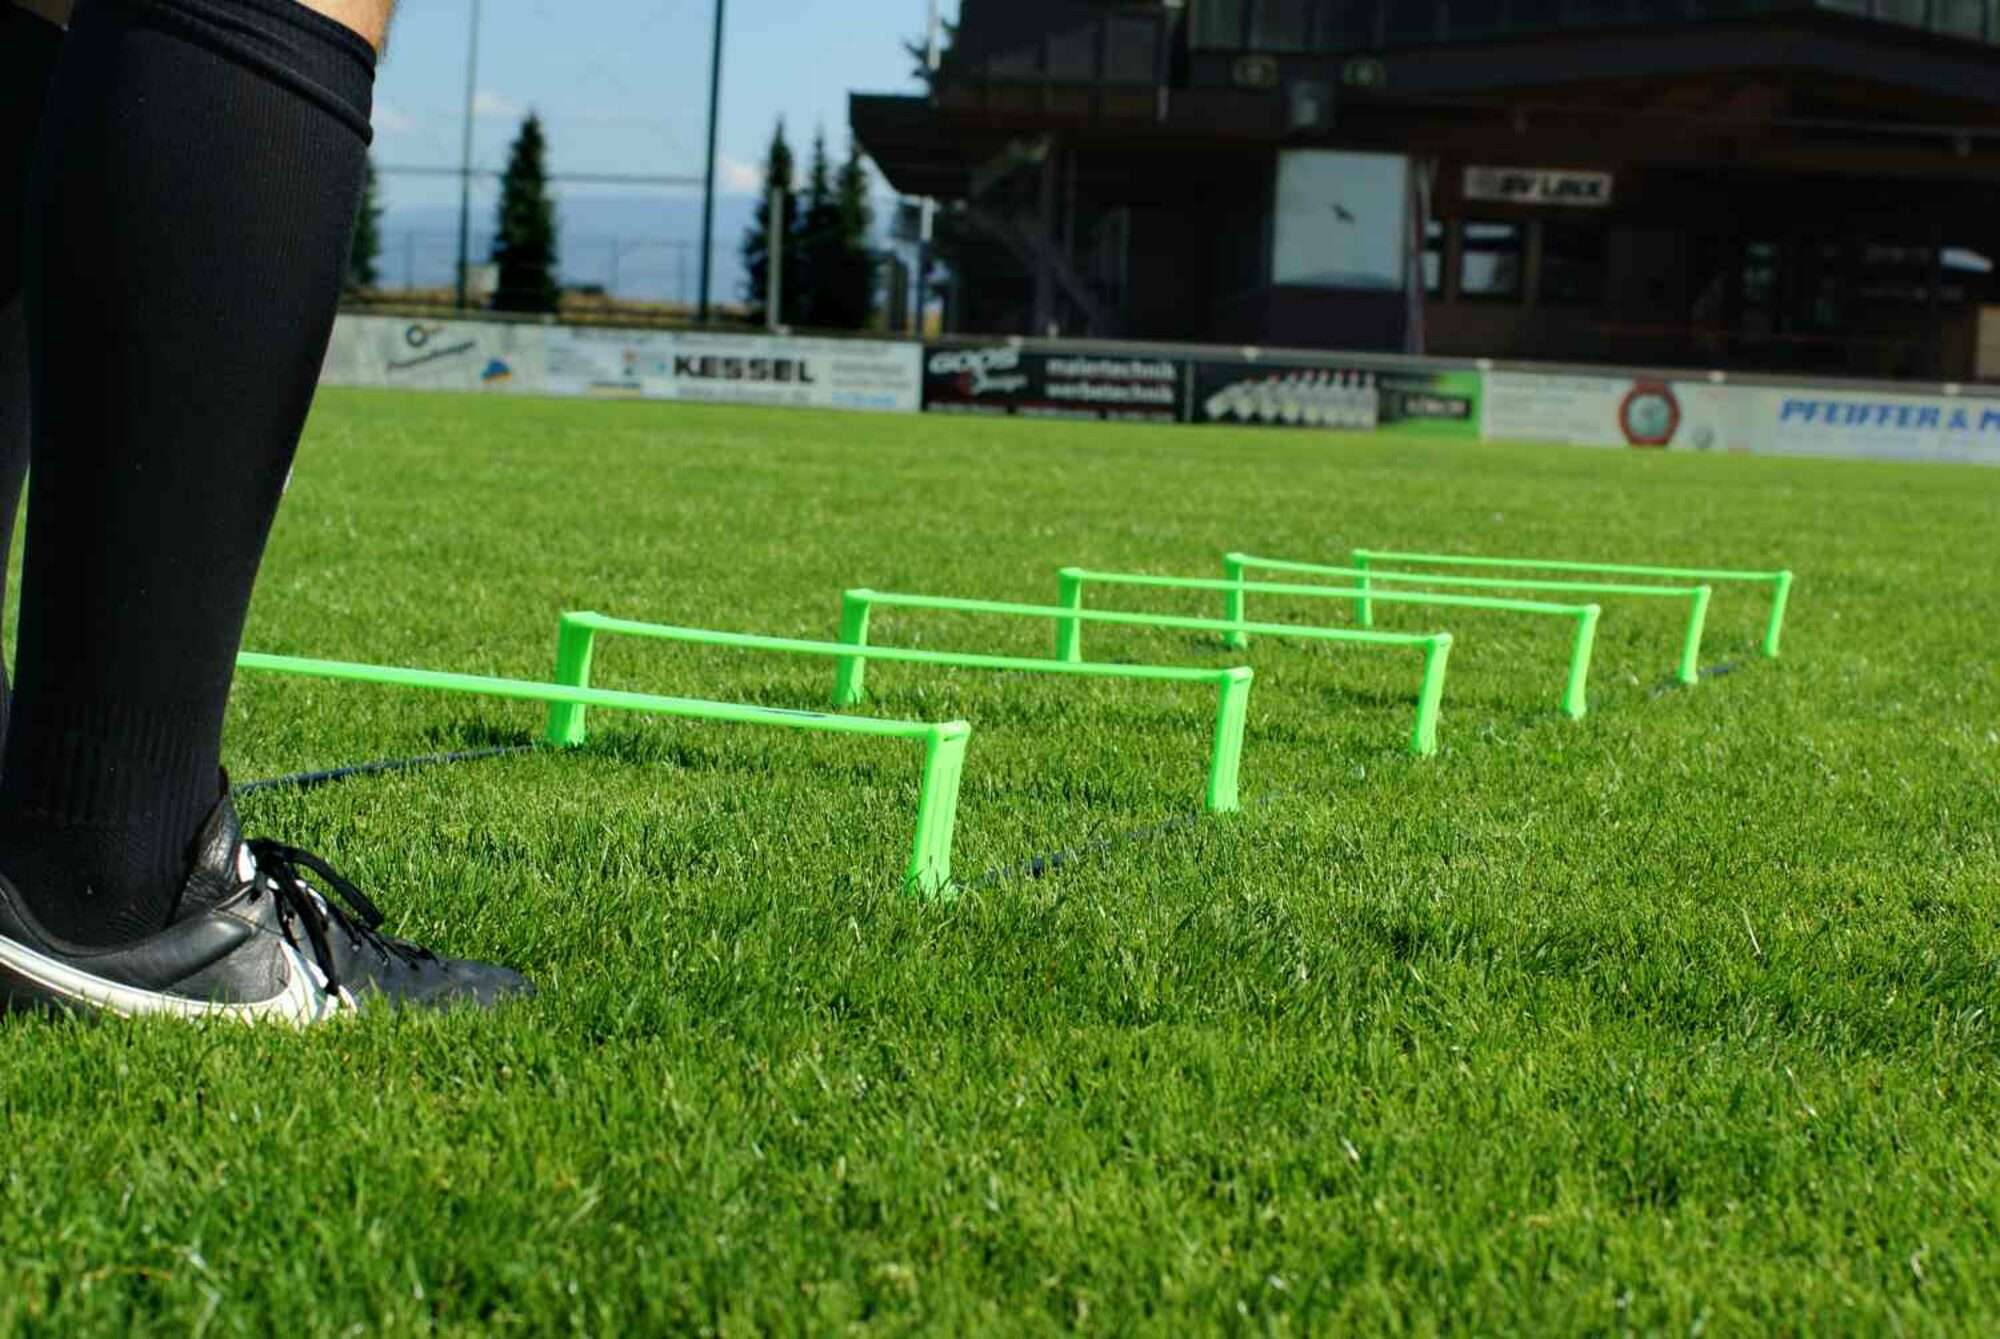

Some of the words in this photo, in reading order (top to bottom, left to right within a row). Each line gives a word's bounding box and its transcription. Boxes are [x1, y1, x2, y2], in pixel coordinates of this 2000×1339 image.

[674, 355, 814, 382] KESSEL
[1780, 399, 1941, 427] PFEIFFER
[1948, 407, 1969, 431] &
